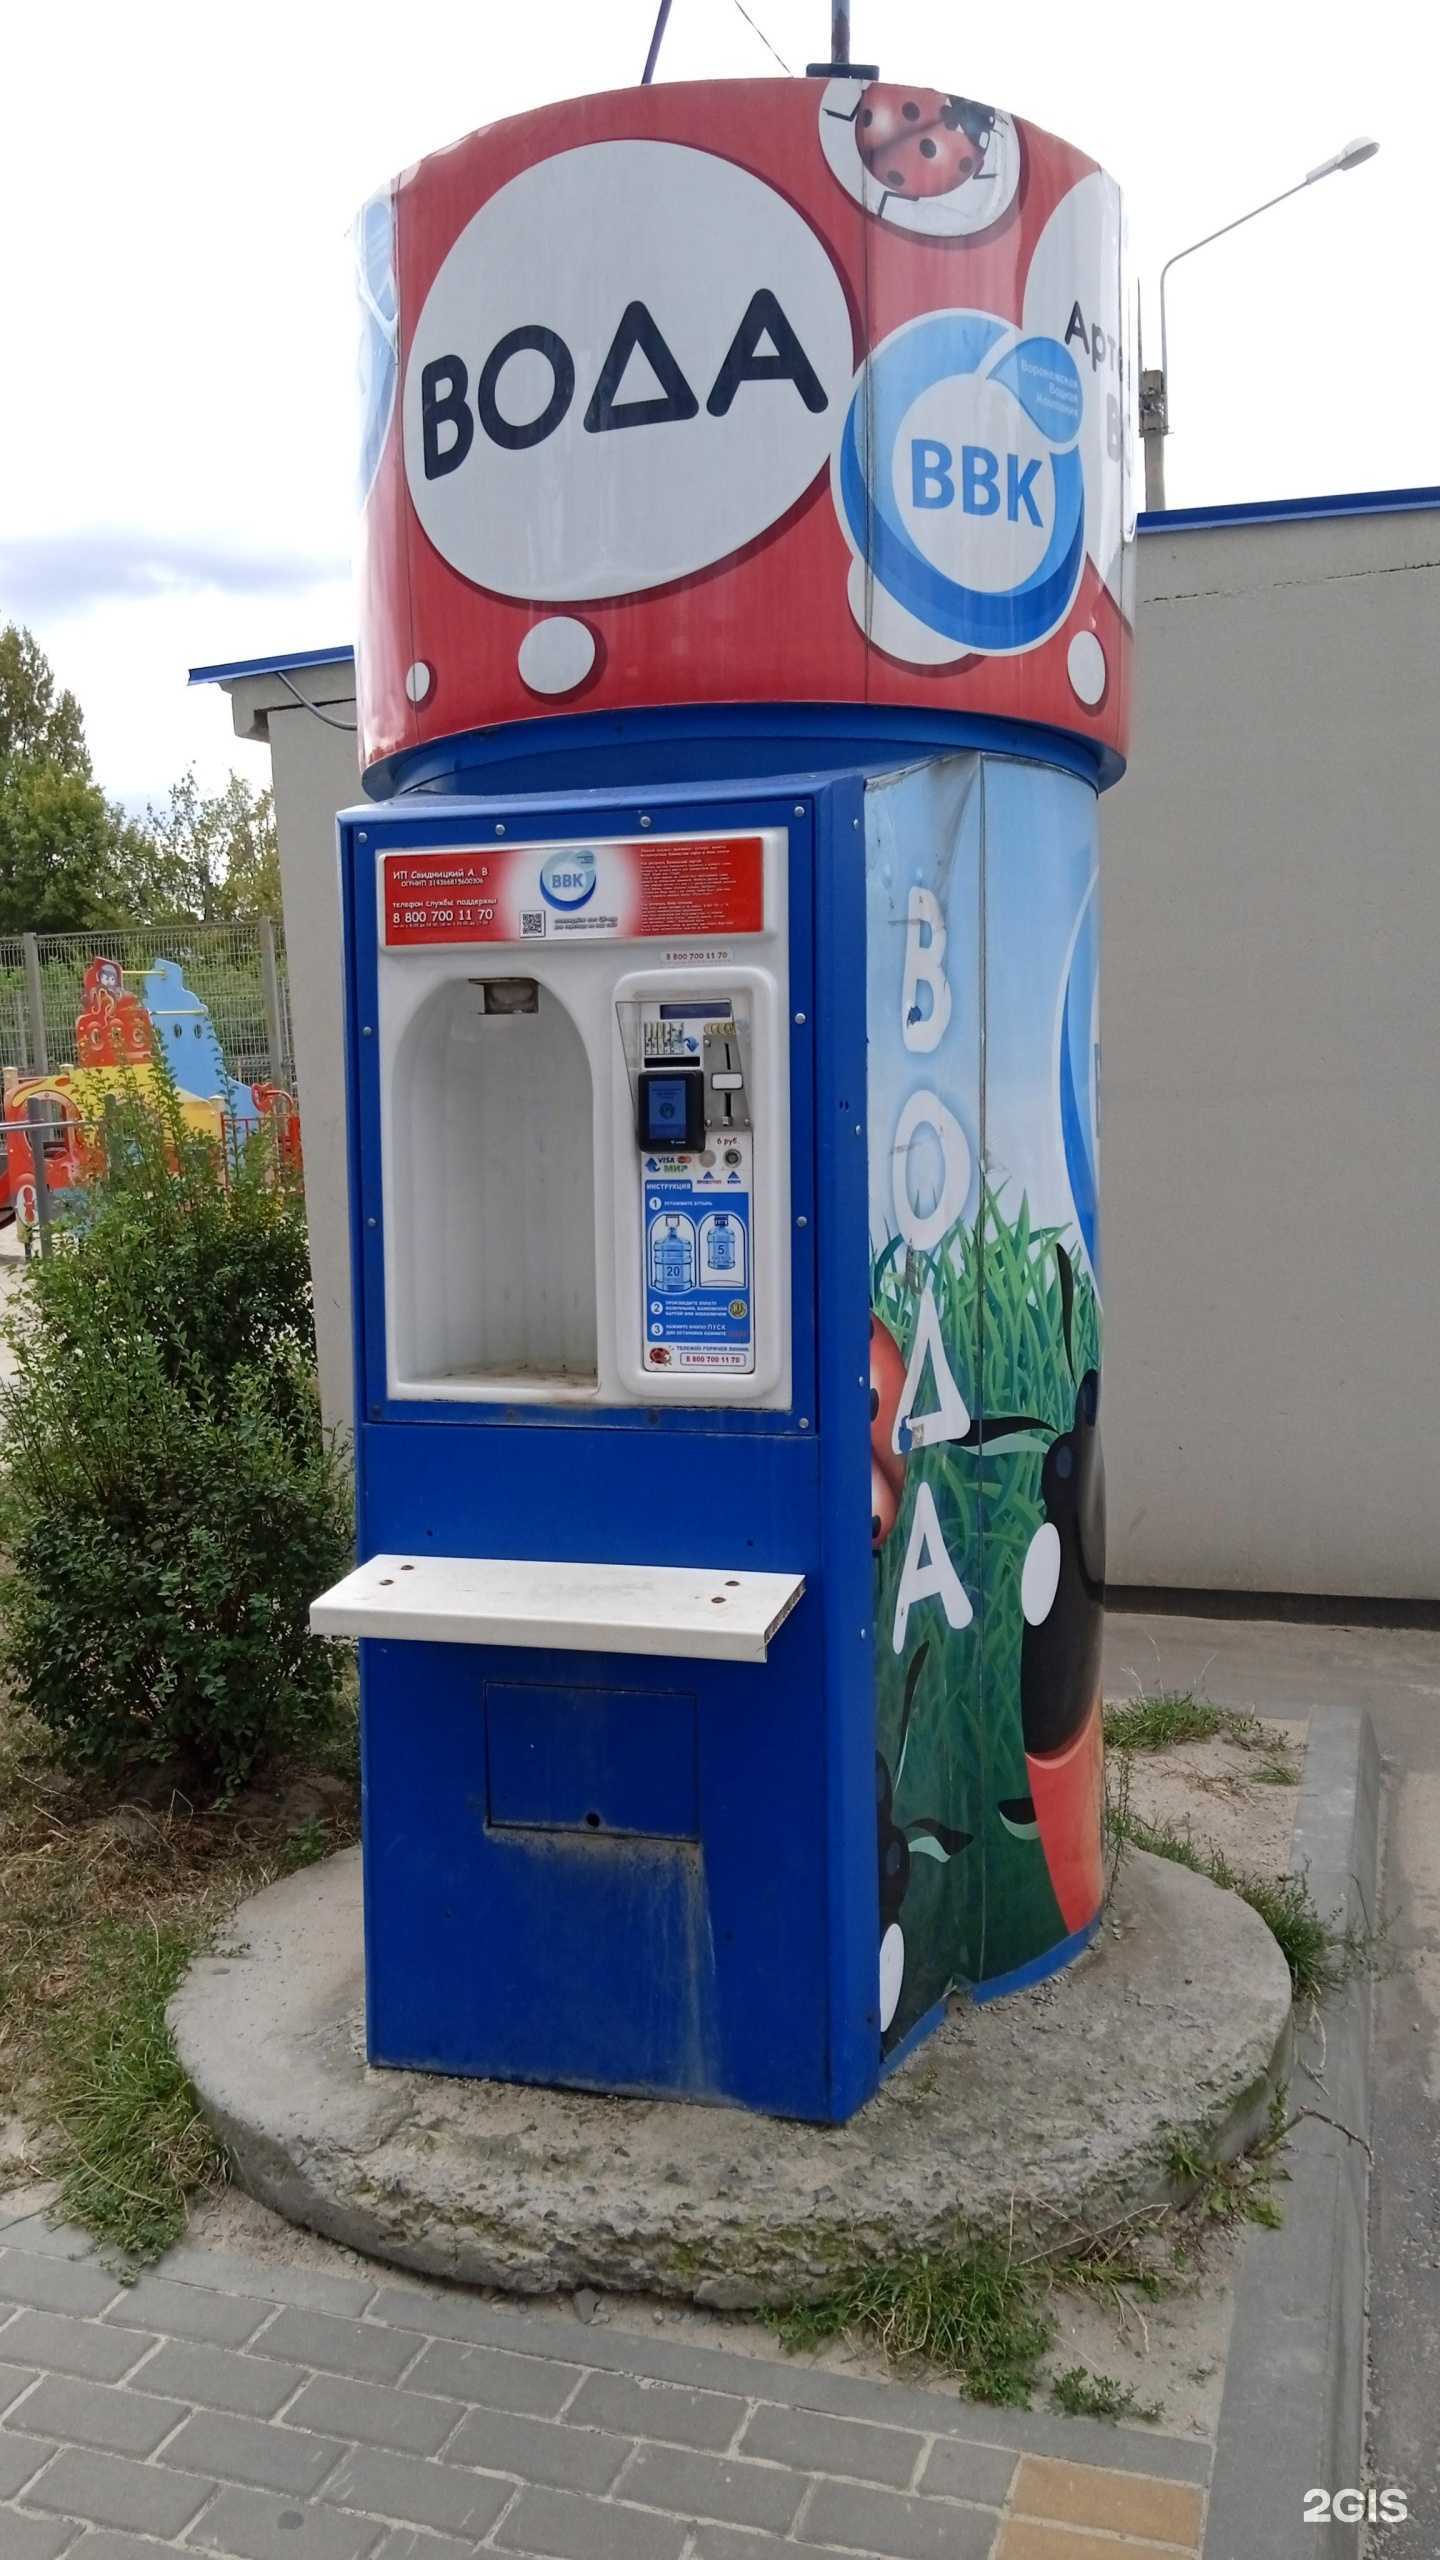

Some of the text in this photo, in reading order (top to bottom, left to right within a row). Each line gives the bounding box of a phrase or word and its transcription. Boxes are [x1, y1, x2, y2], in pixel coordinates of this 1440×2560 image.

[421, 288, 829, 480] ВОДА
[393, 870, 408, 880] ИП
[411, 868, 464, 879] Свидницкий
[392, 901, 424, 909] телефон
[393, 912, 400, 924] 8
[404, 911, 427, 924] 800
[431, 909, 454, 923] 700
[458, 909, 472, 921] 11
[477, 908, 493, 921] 70
[689, 952, 704, 960] 700
[718, 951, 728, 960] 70
[646, 1183, 691, 1191] ИНСТРУКЦИЯ
[718, 1244, 725, 1255] 5
[666, 1266, 680, 1277] 20
